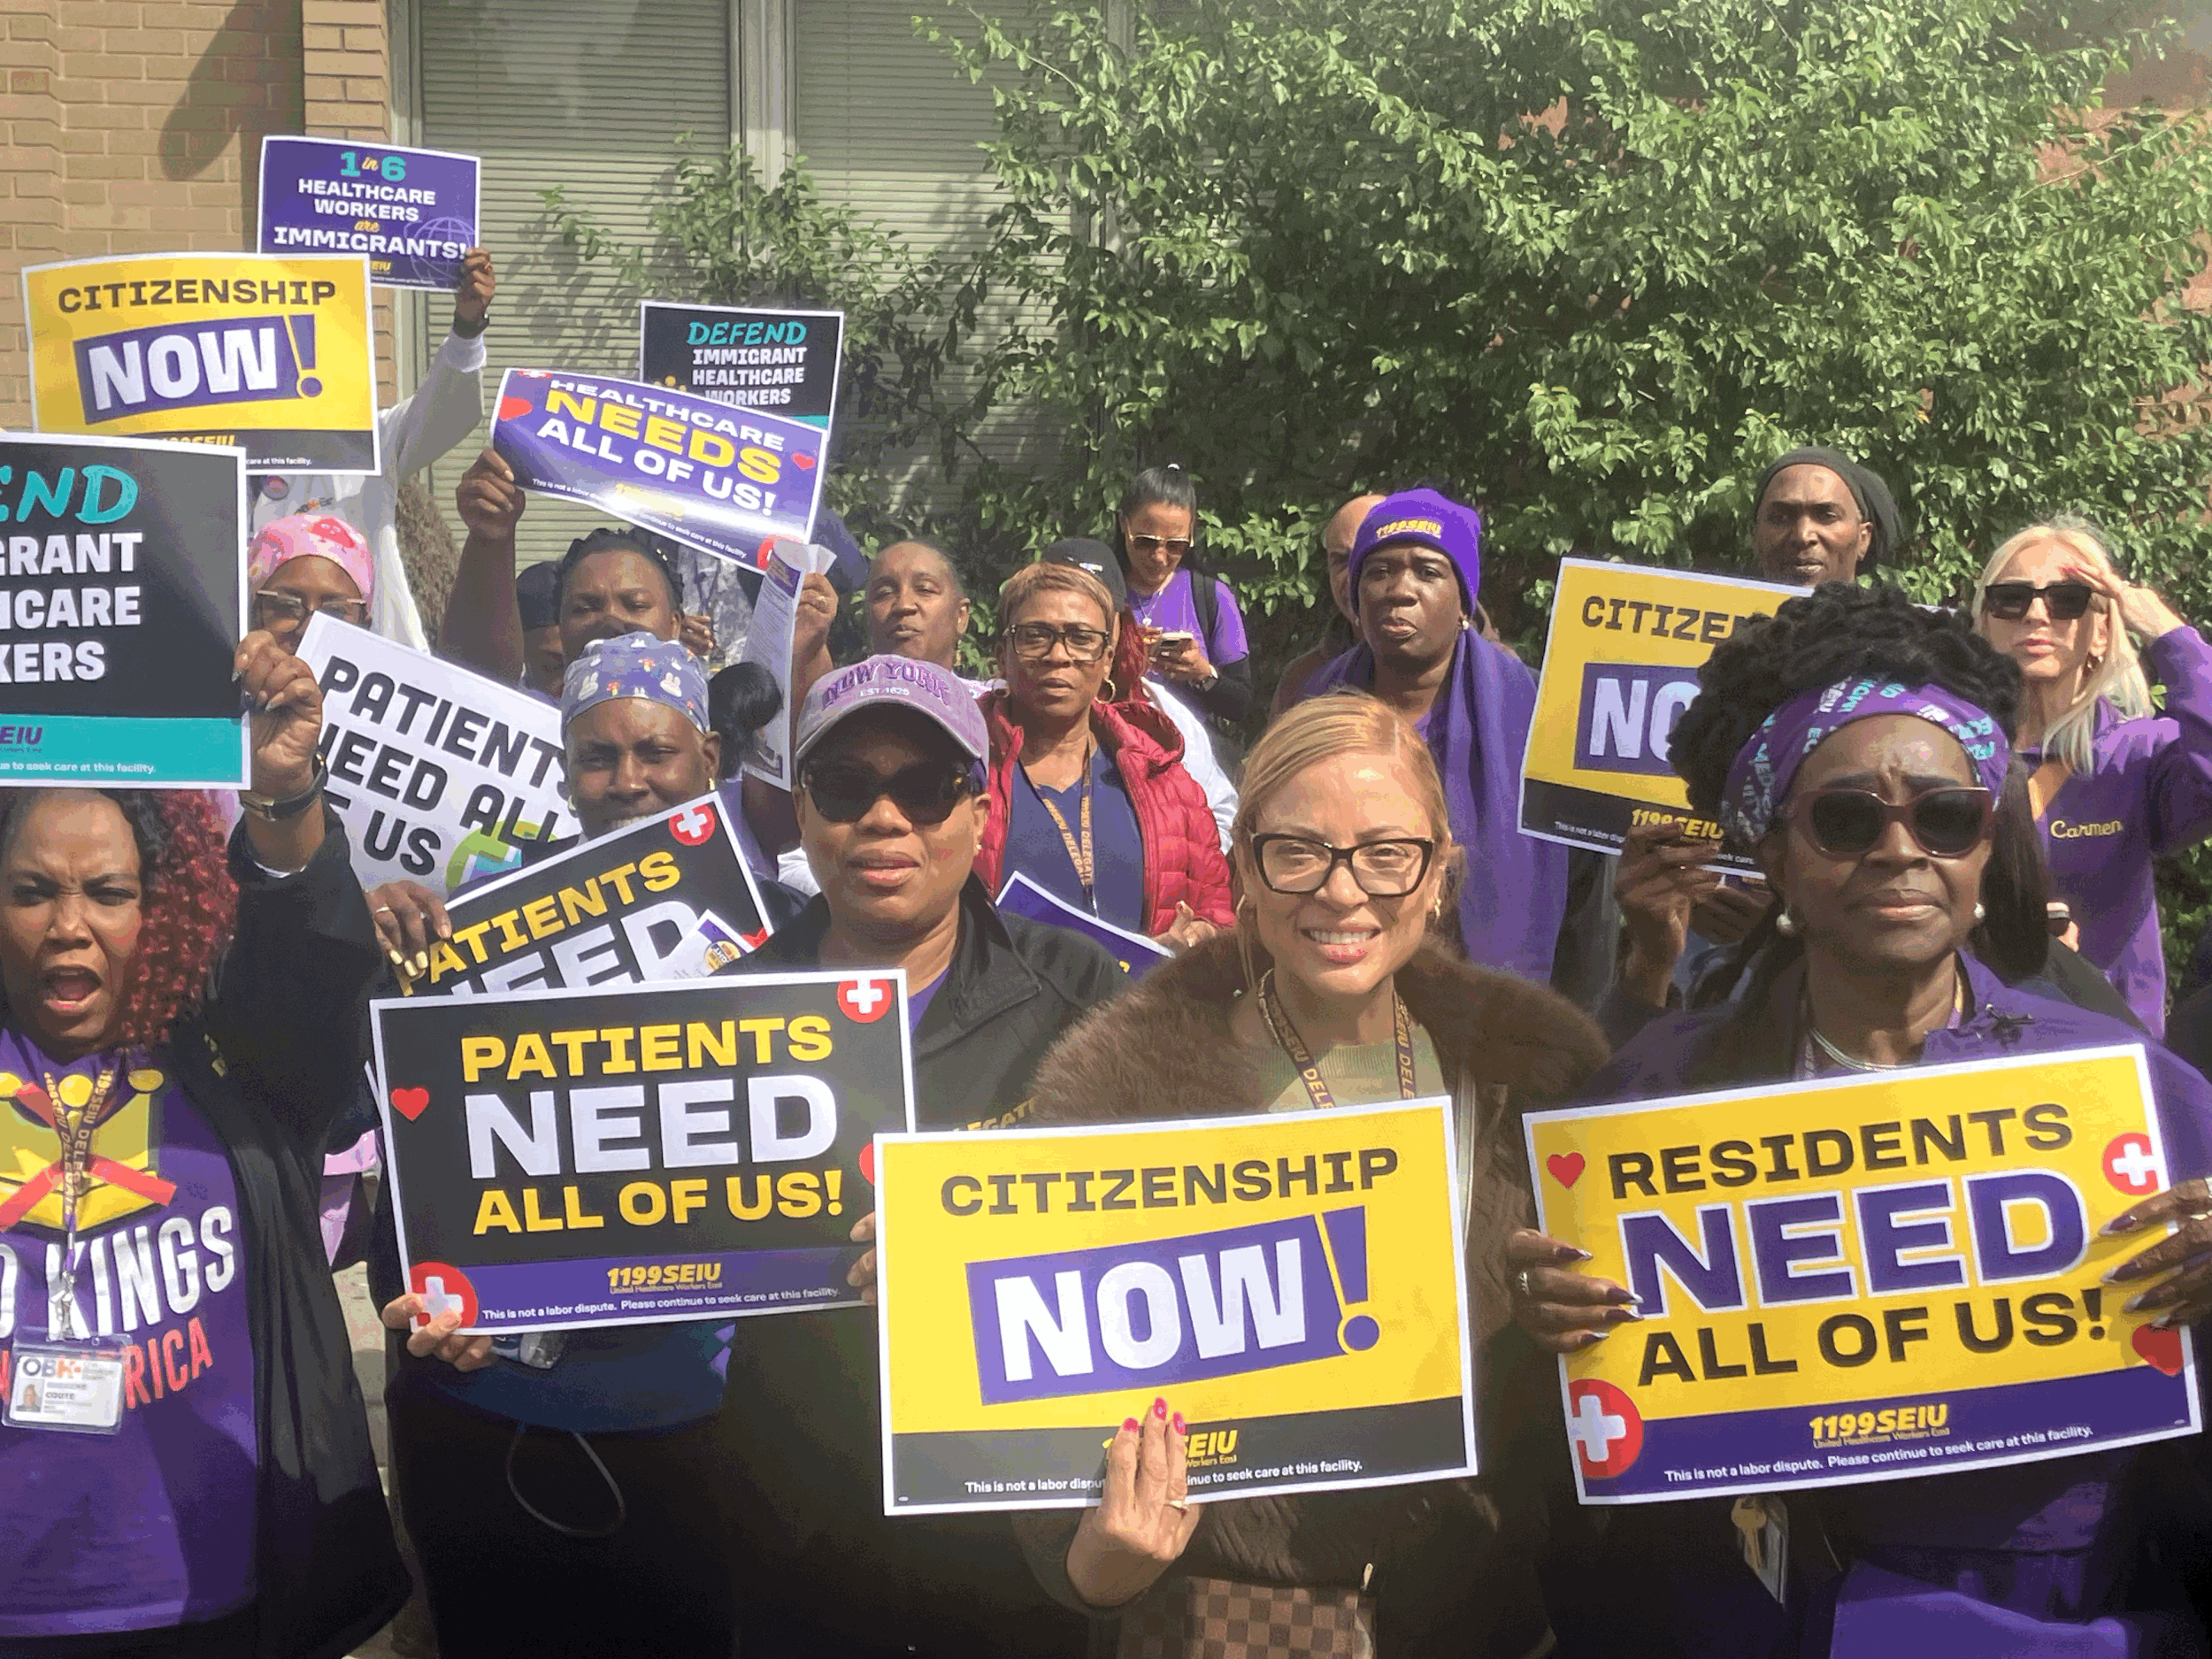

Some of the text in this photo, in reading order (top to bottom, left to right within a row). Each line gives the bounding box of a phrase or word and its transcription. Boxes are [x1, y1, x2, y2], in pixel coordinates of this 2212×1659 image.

[340, 151, 407, 181] 1 in 6
[297, 179, 437, 205] HEALTHCARE
[313, 198, 420, 222] WORKERS
[273, 226, 467, 260] IMMIGRANTS!
[354, 219, 380, 233] are
[58, 279, 336, 313] CITIZENSHIP
[687, 321, 807, 345] DEFEND
[692, 347, 807, 365] IMMIGRANT
[88, 313, 324, 411] NOW!
[692, 367, 804, 386] HEALTHCARE
[549, 379, 786, 452] HEALTHCARE
[704, 388, 791, 406] WORKERS
[544, 389, 782, 485] NEEDS
[536, 418, 624, 465] ALL
[633, 449, 695, 483] OF
[702, 470, 777, 517] US!
[821, 662, 952, 711] NEW YORK
[320, 655, 571, 797] PATIENT
[12, 762, 24, 771] to
[54, 763, 78, 772] care
[80, 763, 91, 772] at
[94, 762, 115, 772] this
[363, 810, 442, 876] US
[2050, 819, 2124, 839] Carmen
[460, 1015, 833, 1083] PATIENTS
[464, 1073, 838, 1180] NEED
[1608, 1102, 2074, 1200] RESIDENTS
[472, 1168, 843, 1235] ALL OF US!
[941, 1147, 1399, 1217] CITIZENSHIP
[1617, 1166, 2090, 1319] NEED
[45, 1205, 236, 1340] KINGS
[607, 1263, 722, 1287] 1199SEIU
[993, 1205, 1380, 1382] NOW!
[481, 1309, 505, 1320] This
[507, 1309, 517, 1318] is
[518, 1308, 536, 1317] not
[537, 1307, 545, 1316] a
[546, 1305, 573, 1316] labor
[574, 1302, 618, 1315] dispute.
[621, 1298, 656, 1310] Please
[657, 1296, 703, 1308] continue
[704, 1295, 717, 1304] to
[718, 1293, 742, 1304] seek
[743, 1293, 767, 1302] care
[768, 1291, 780, 1301] at
[780, 1288, 801, 1300] this
[1637, 1287, 2107, 1387] ALL OF US!
[1809, 1403, 1948, 1440] 1199SEIU
[964, 1481, 992, 1494] This
[993, 1481, 1004, 1493] is
[1006, 1480, 1026, 1492] not
[1028, 1481, 1036, 1491] a
[1037, 1479, 1068, 1491] labor
[1212, 1473, 1225, 1483] to
[1226, 1469, 1254, 1480] seek
[1255, 1468, 1280, 1479] care
[1281, 1466, 1294, 1476] at
[1295, 1463, 1318, 1475] this
[1320, 1459, 1363, 1472] facility.
[1664, 1470, 1693, 1483] This
[1694, 1468, 1706, 1479] is
[1707, 1467, 1729, 1479] not
[1739, 1462, 1770, 1476] labor
[1772, 1459, 1824, 1474] dispute.
[1827, 1453, 1870, 1468] Please
[1871, 1448, 1928, 1464] continue
[1928, 1446, 1944, 1457] to
[1945, 1440, 1976, 1455] seek
[1976, 1439, 2006, 1452] care
[2006, 1436, 2021, 1448] at
[2021, 1430, 2047, 1446] this
